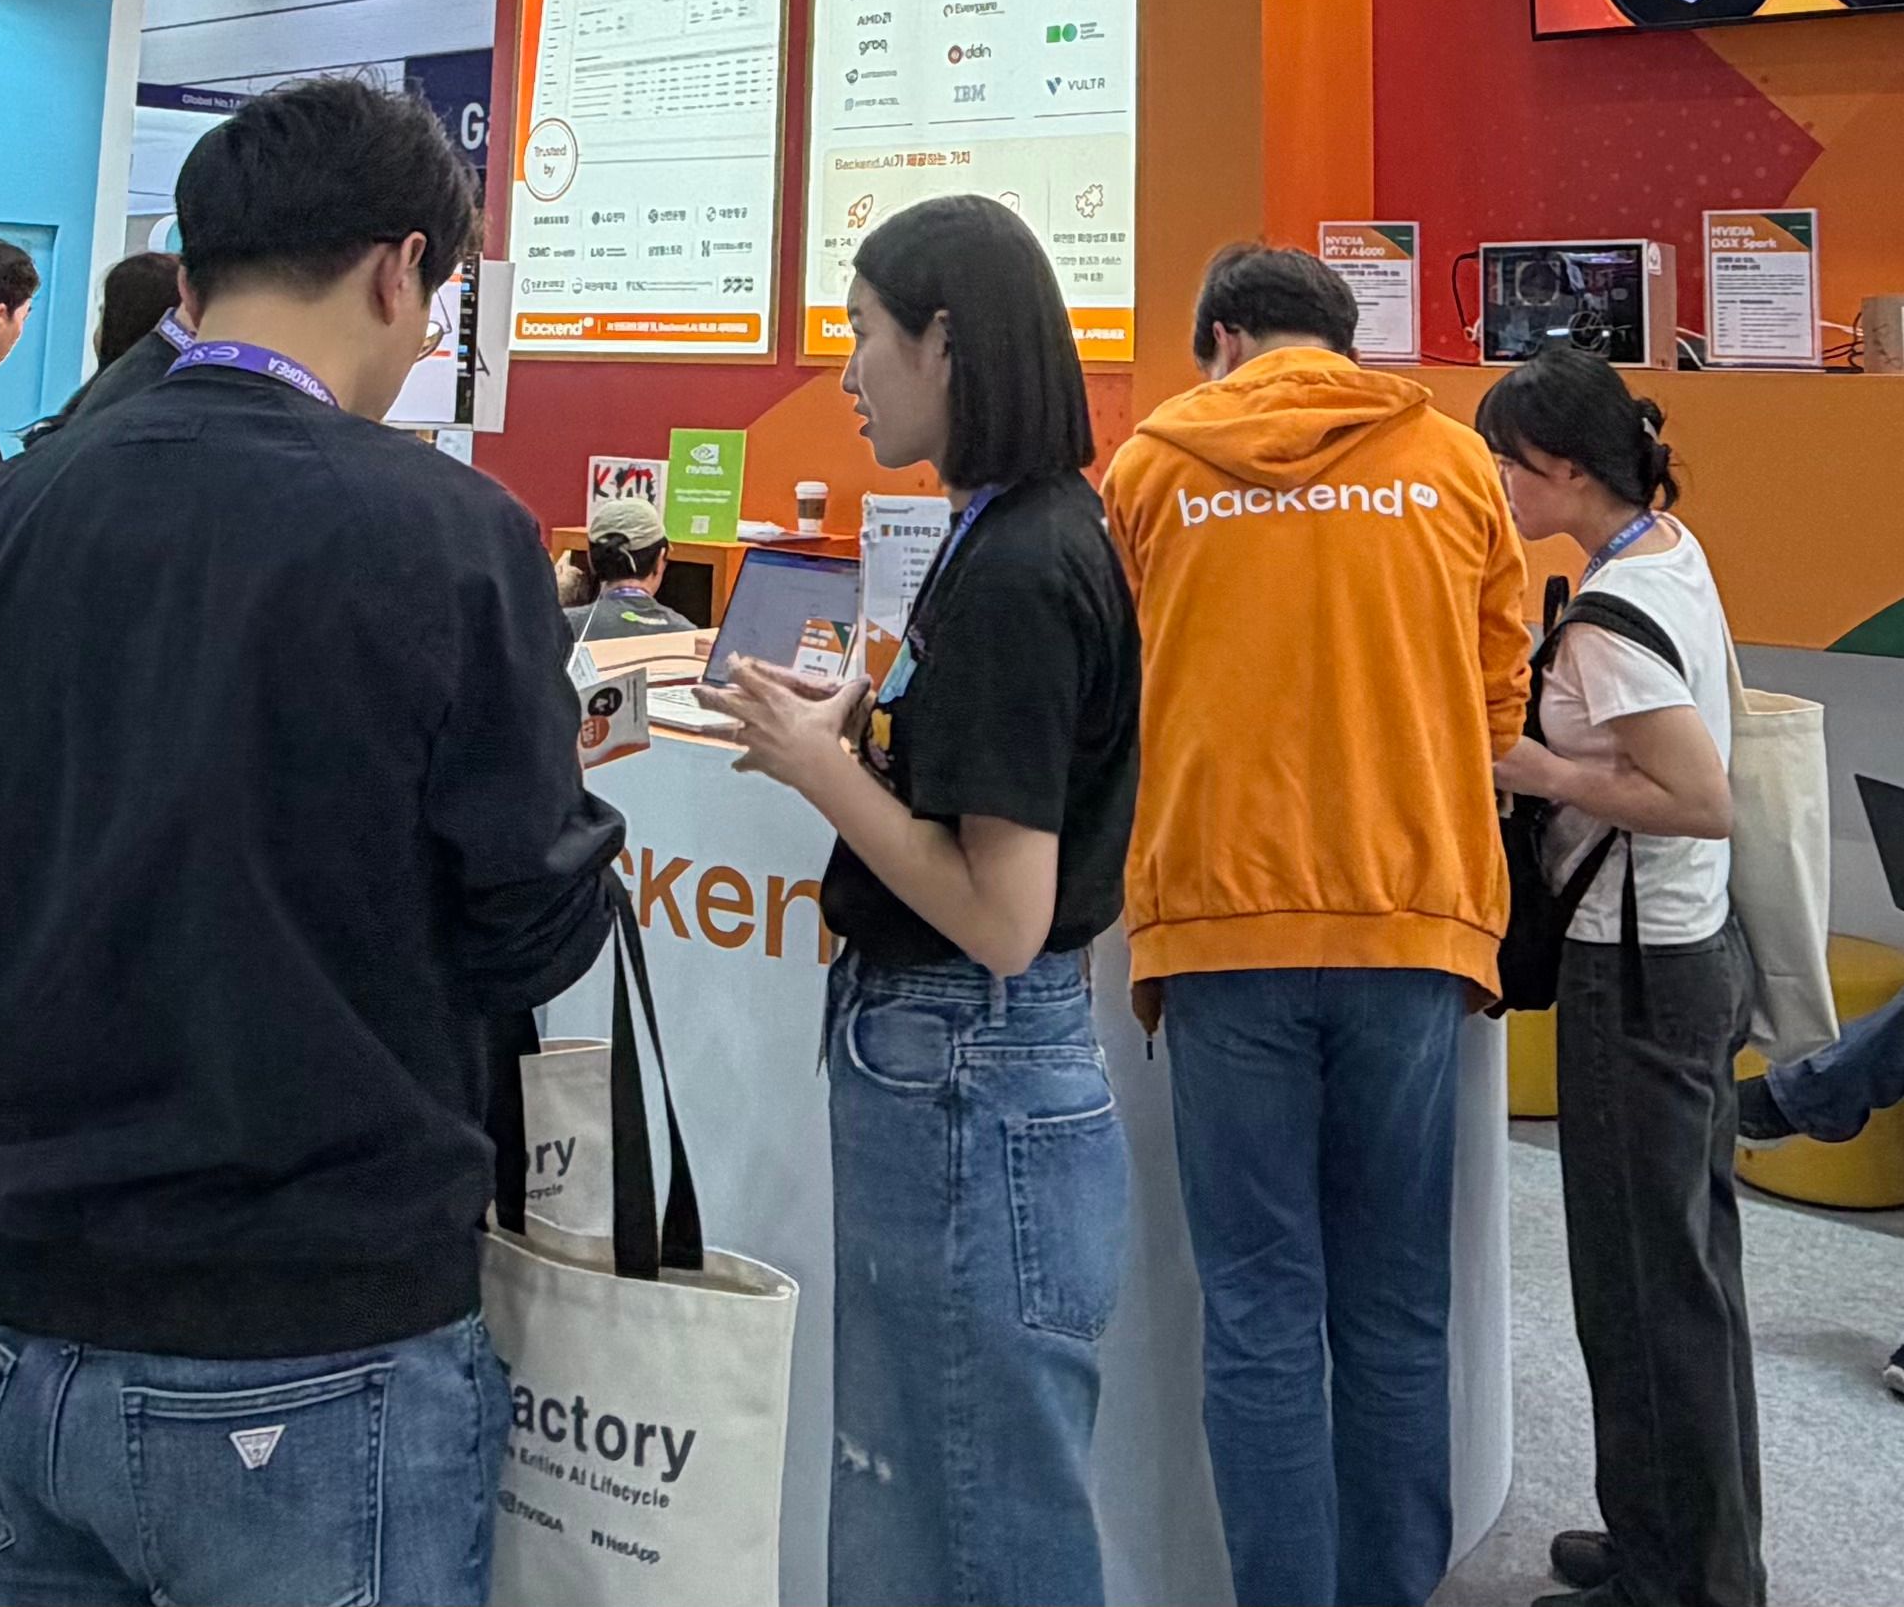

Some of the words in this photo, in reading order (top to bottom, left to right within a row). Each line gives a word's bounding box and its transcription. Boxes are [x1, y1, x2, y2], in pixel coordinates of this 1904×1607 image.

[857, 14, 882, 26] AMD
[965, 43, 992, 59] ddn
[1067, 77, 1106, 90] VULTR
[953, 83, 986, 103] IBM
[461, 102, 490, 151] G
[543, 164, 555, 178] by
[1325, 236, 1364, 246] NVIDIA
[1743, 238, 1777, 249] Spark
[1177, 478, 1403, 527] backend
[519, 1447, 565, 1479] Entire
[569, 1466, 586, 1486] AI
[590, 1473, 670, 1509] Lifecycle
